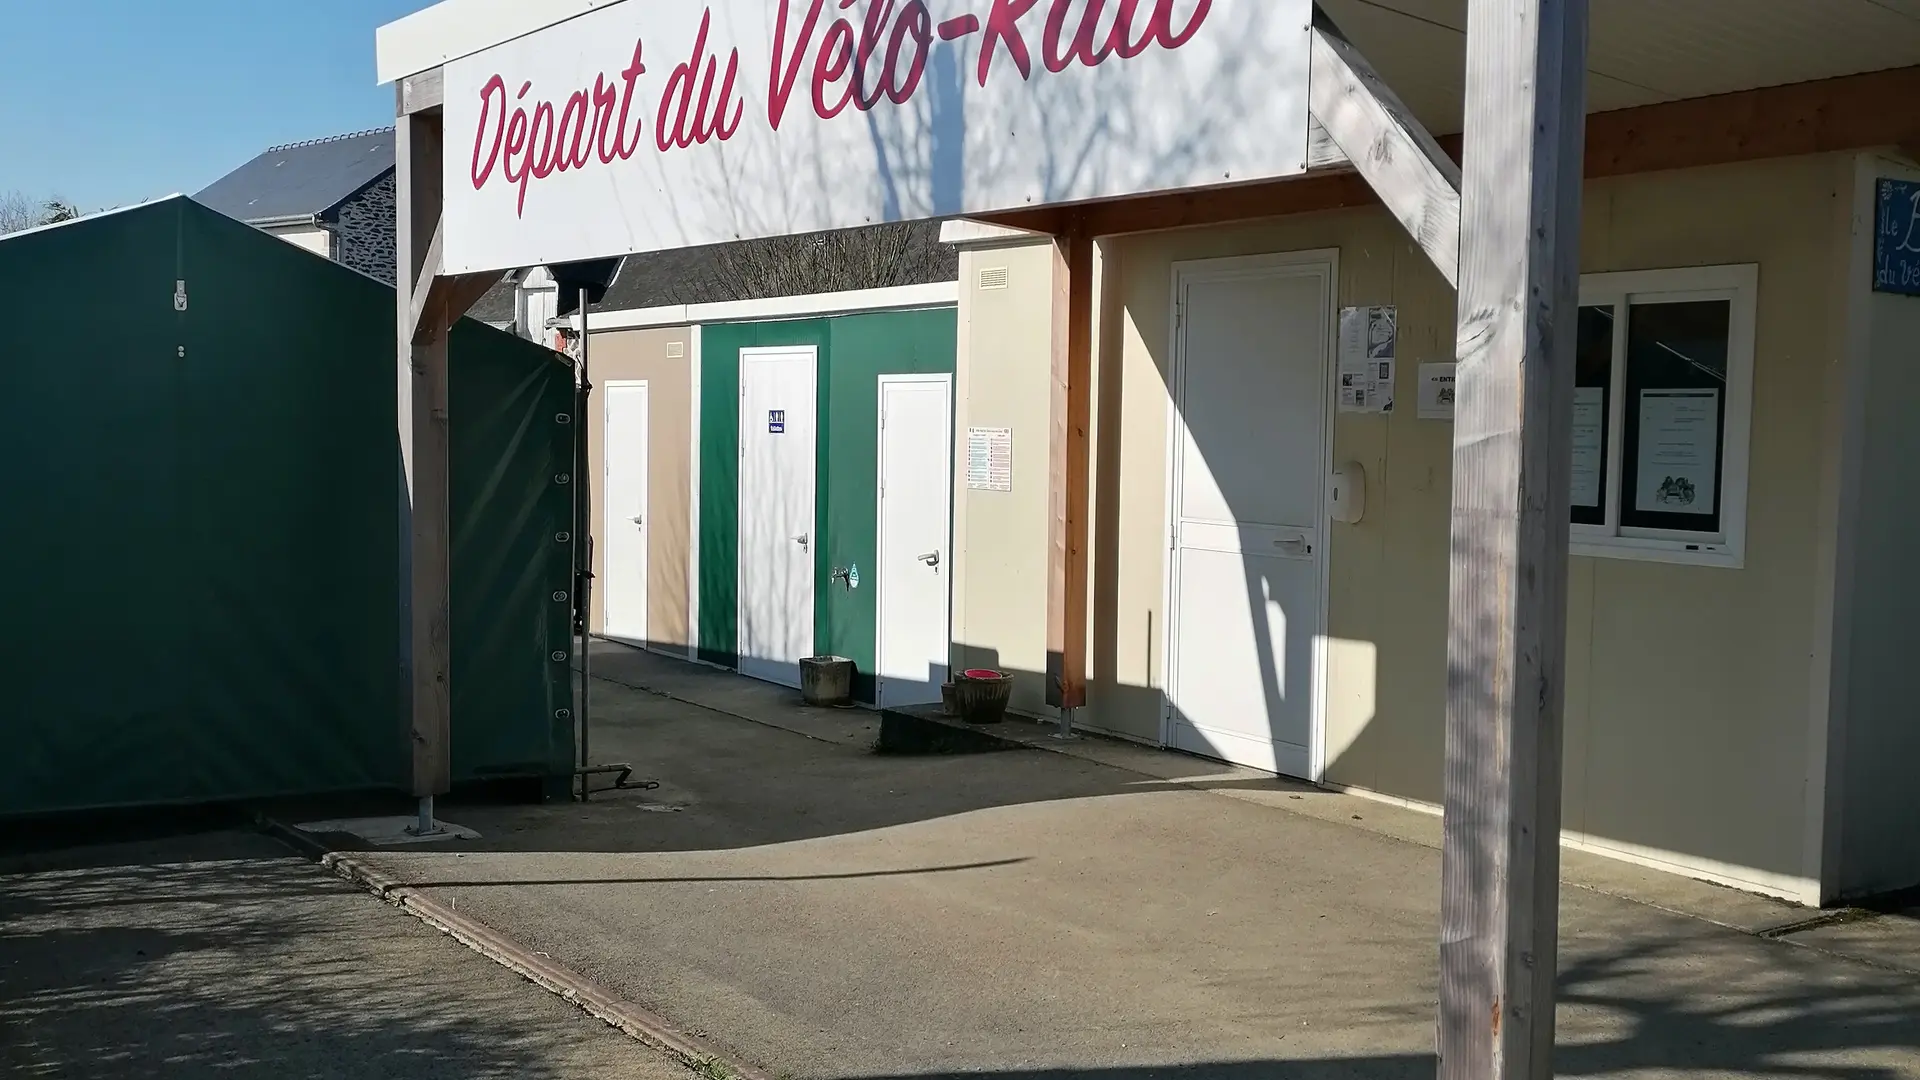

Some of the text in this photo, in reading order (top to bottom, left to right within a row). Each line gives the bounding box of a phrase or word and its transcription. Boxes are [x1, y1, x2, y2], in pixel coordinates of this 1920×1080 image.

[471, 0, 1212, 219] Départ du Vélo-Ra
[1879, 254, 1896, 285] du
